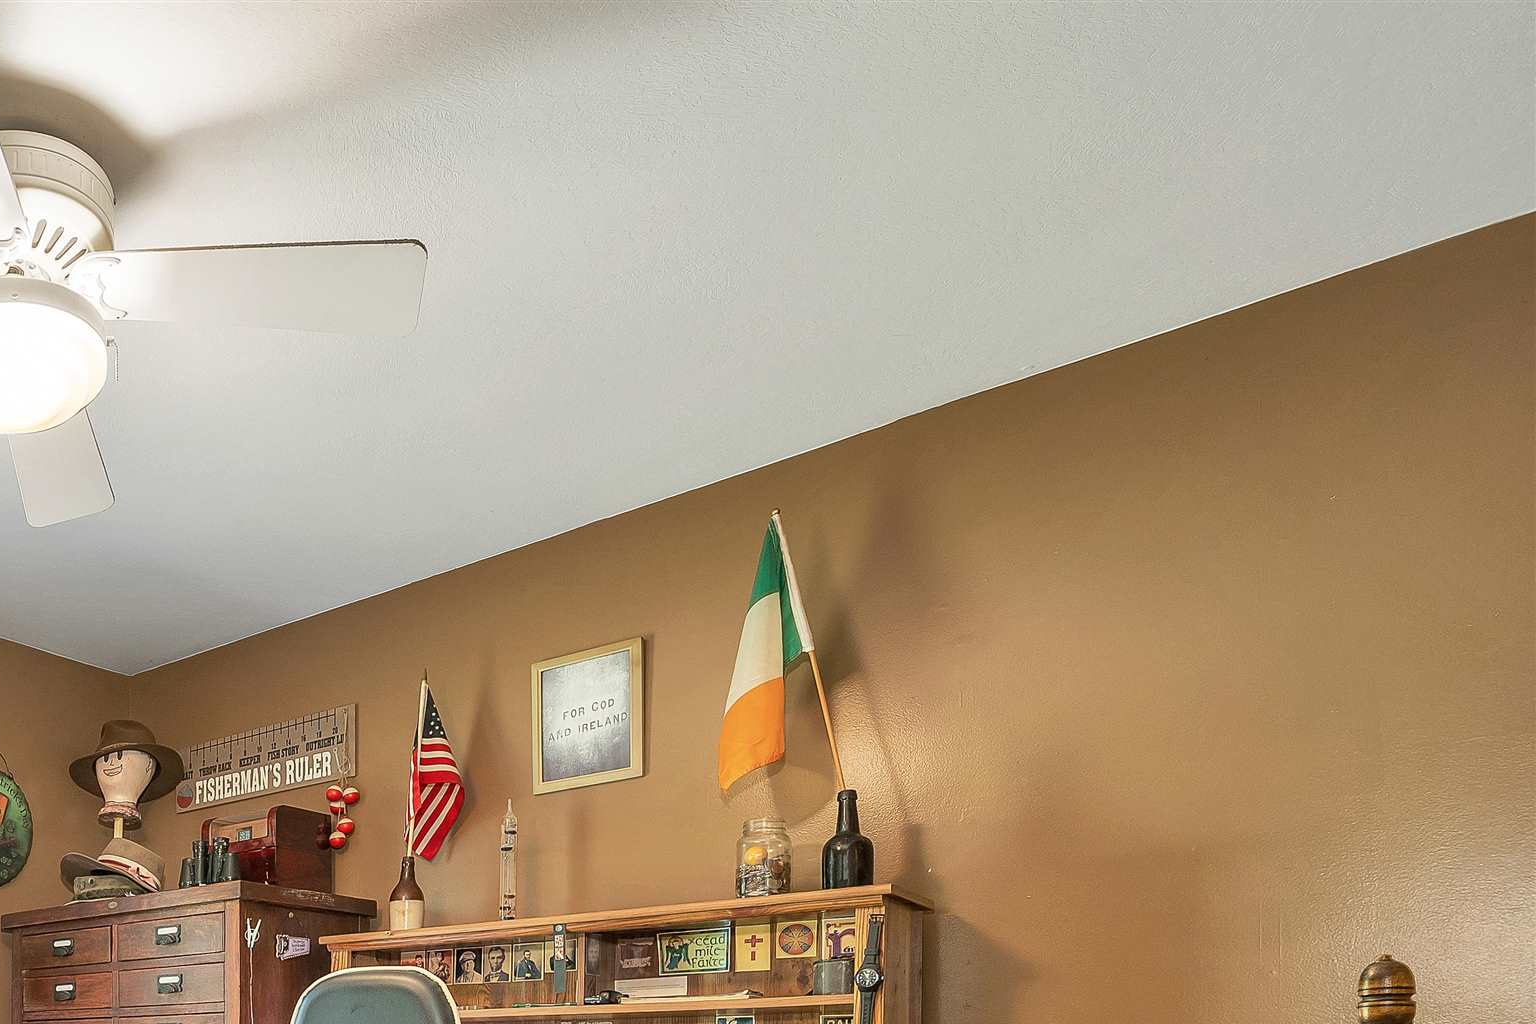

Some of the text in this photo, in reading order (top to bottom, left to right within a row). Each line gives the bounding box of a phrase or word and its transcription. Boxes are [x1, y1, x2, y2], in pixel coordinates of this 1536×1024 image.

[562, 706, 585, 721] FOR
[281, 744, 300, 758] STORY
[305, 735, 335, 752] OUTRIGHT
[194, 751, 332, 805] FISHERMAN'S RULER
